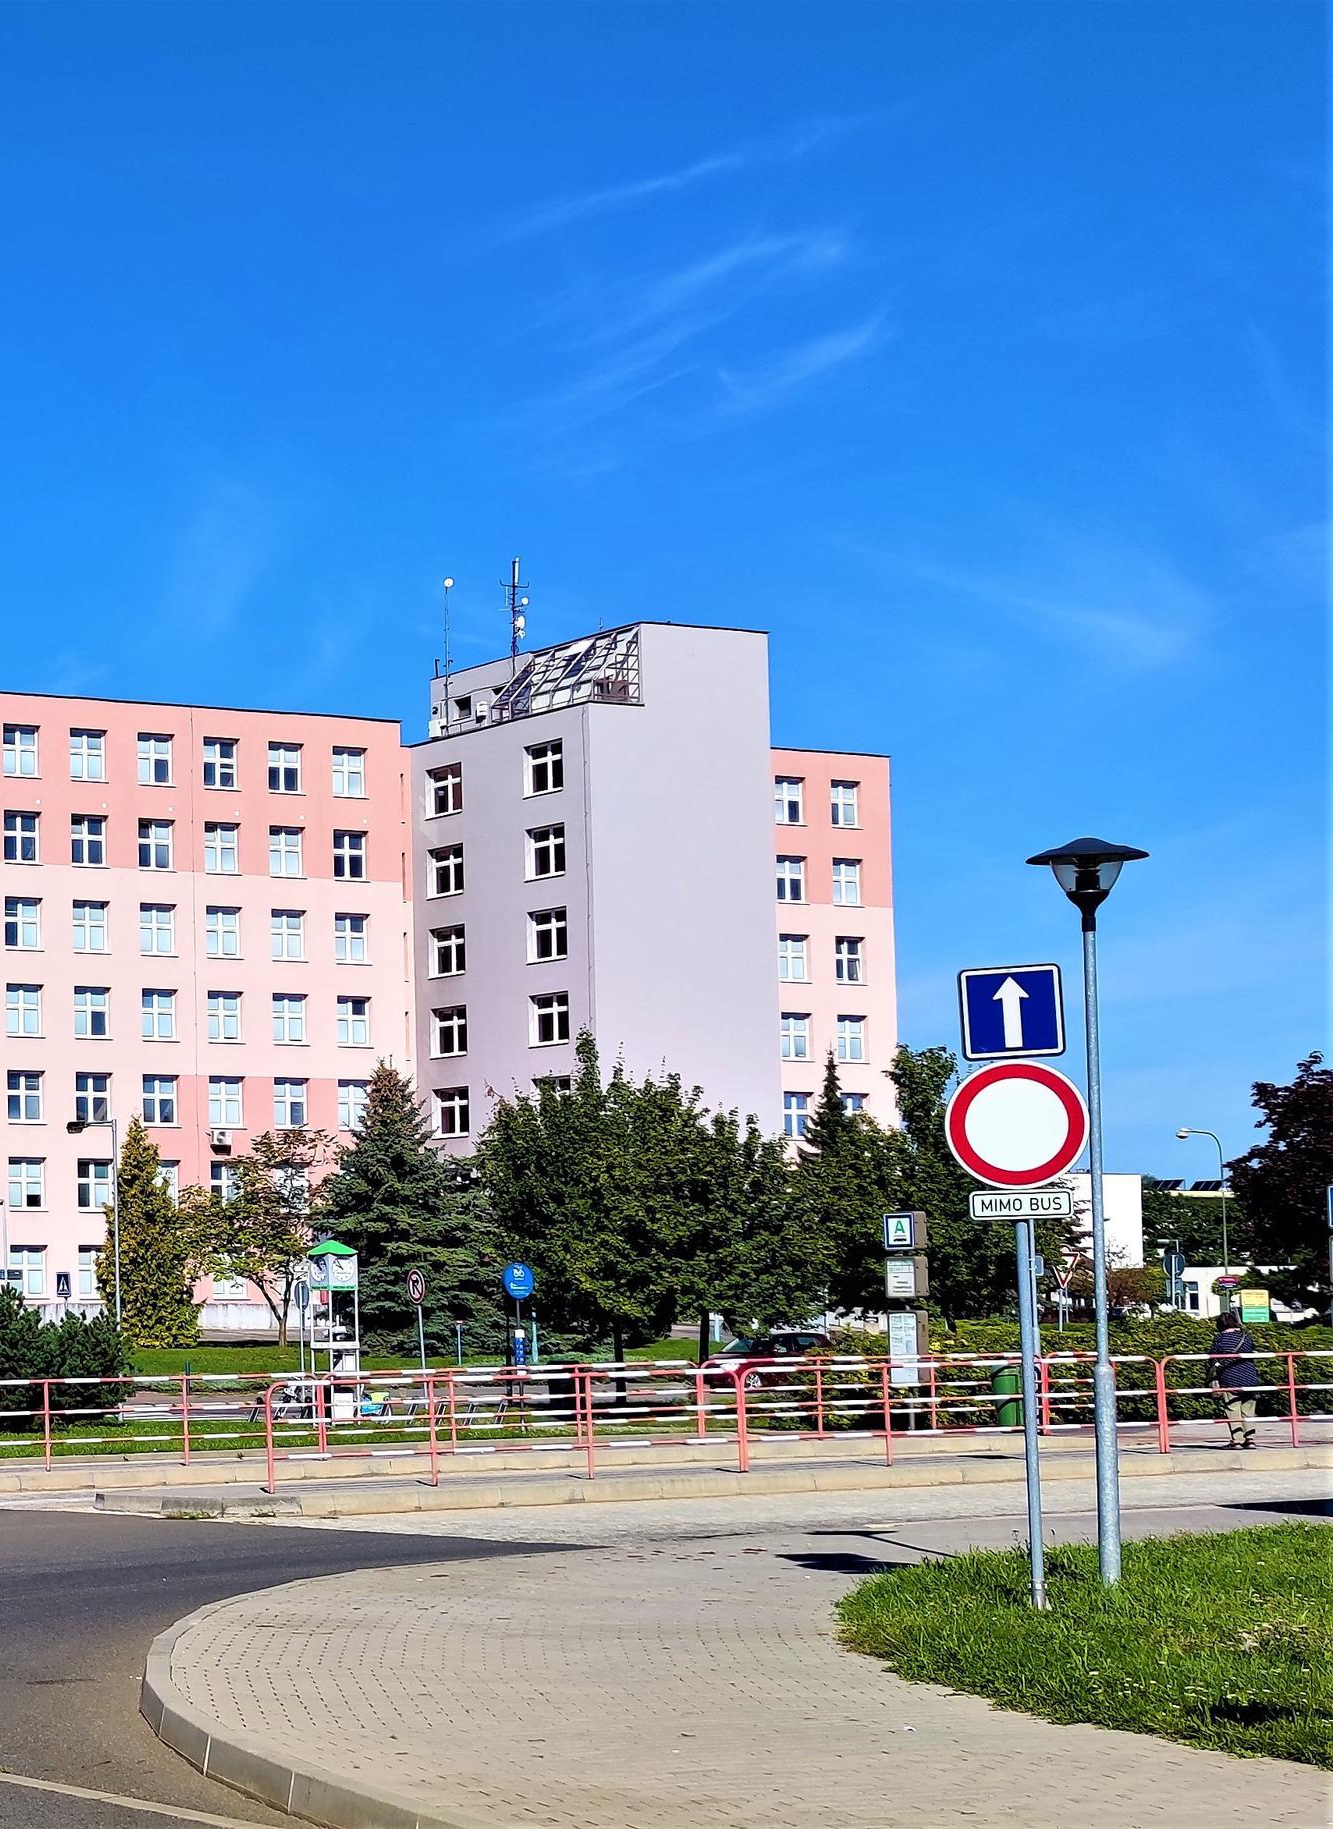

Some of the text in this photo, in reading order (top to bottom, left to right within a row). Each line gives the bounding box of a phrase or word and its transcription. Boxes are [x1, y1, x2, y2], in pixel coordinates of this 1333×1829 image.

[981, 1196, 1062, 1212] MIMO BUS
[894, 1220, 906, 1234] A
